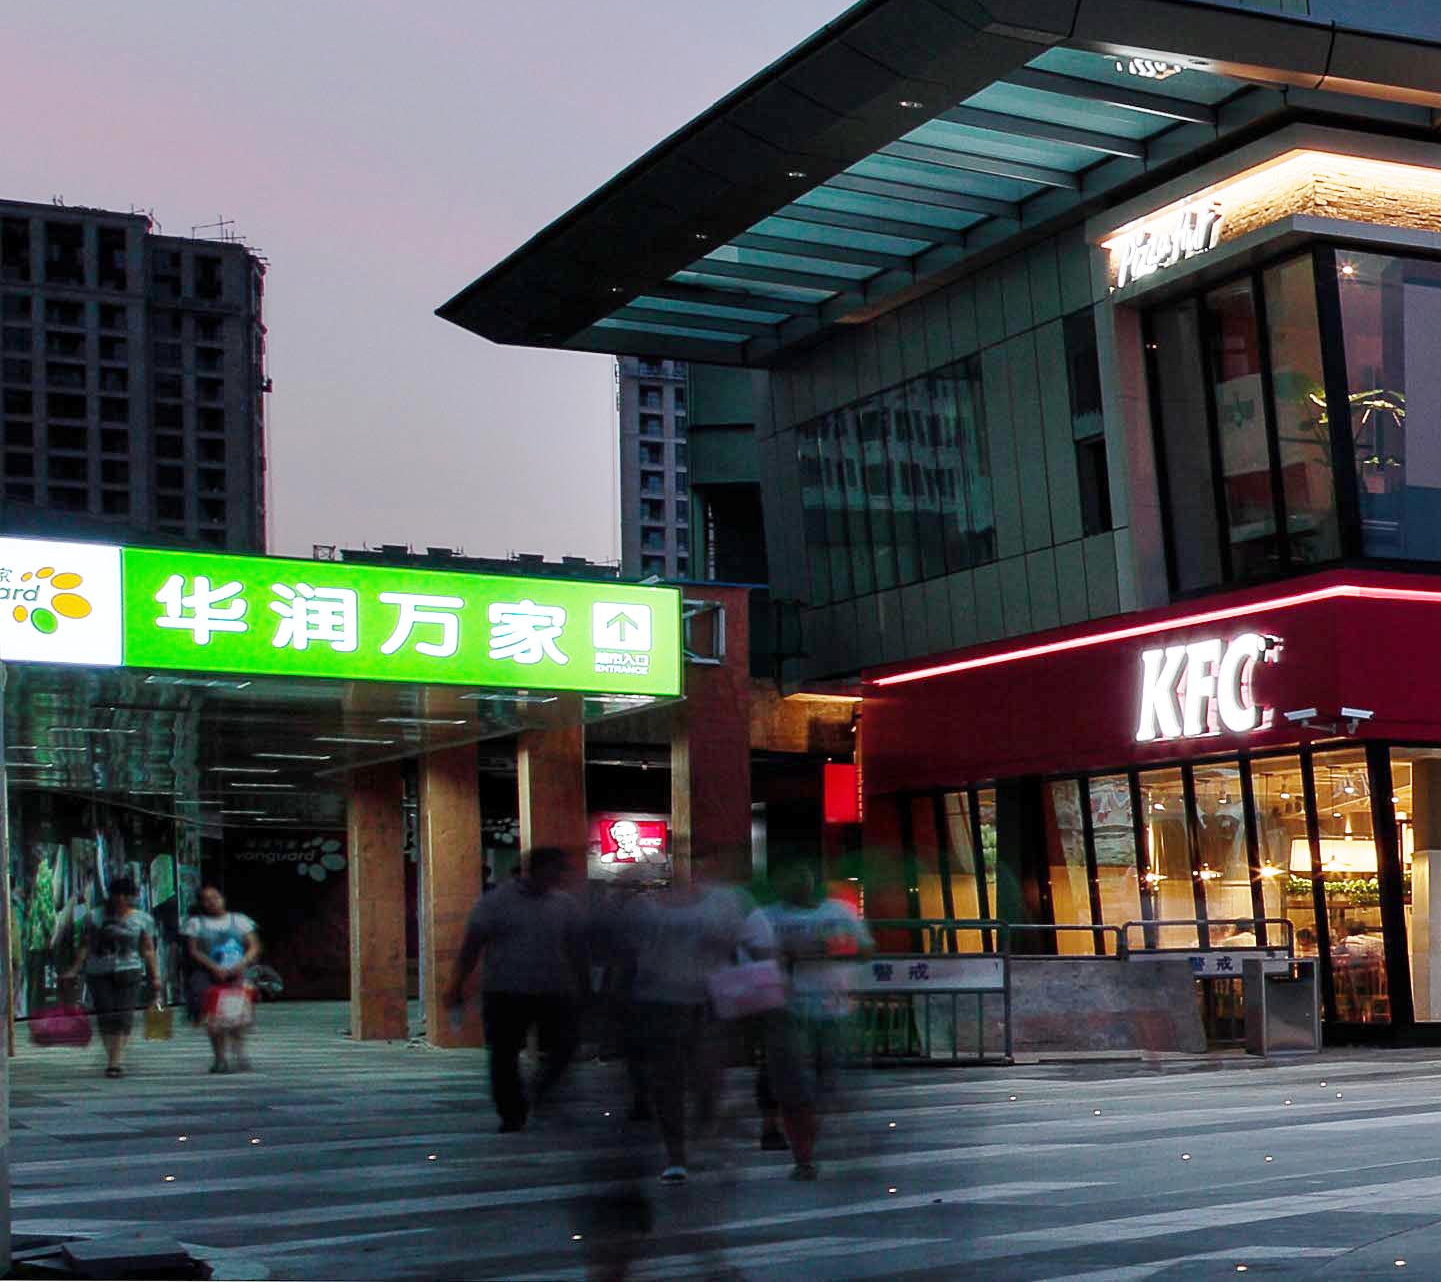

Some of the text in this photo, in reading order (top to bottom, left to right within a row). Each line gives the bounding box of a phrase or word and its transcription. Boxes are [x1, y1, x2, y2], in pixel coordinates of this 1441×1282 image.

[153, 573, 569, 666] 华润万家
[1135, 632, 1273, 743] KFC
[872, 962, 929, 982] 警戒
